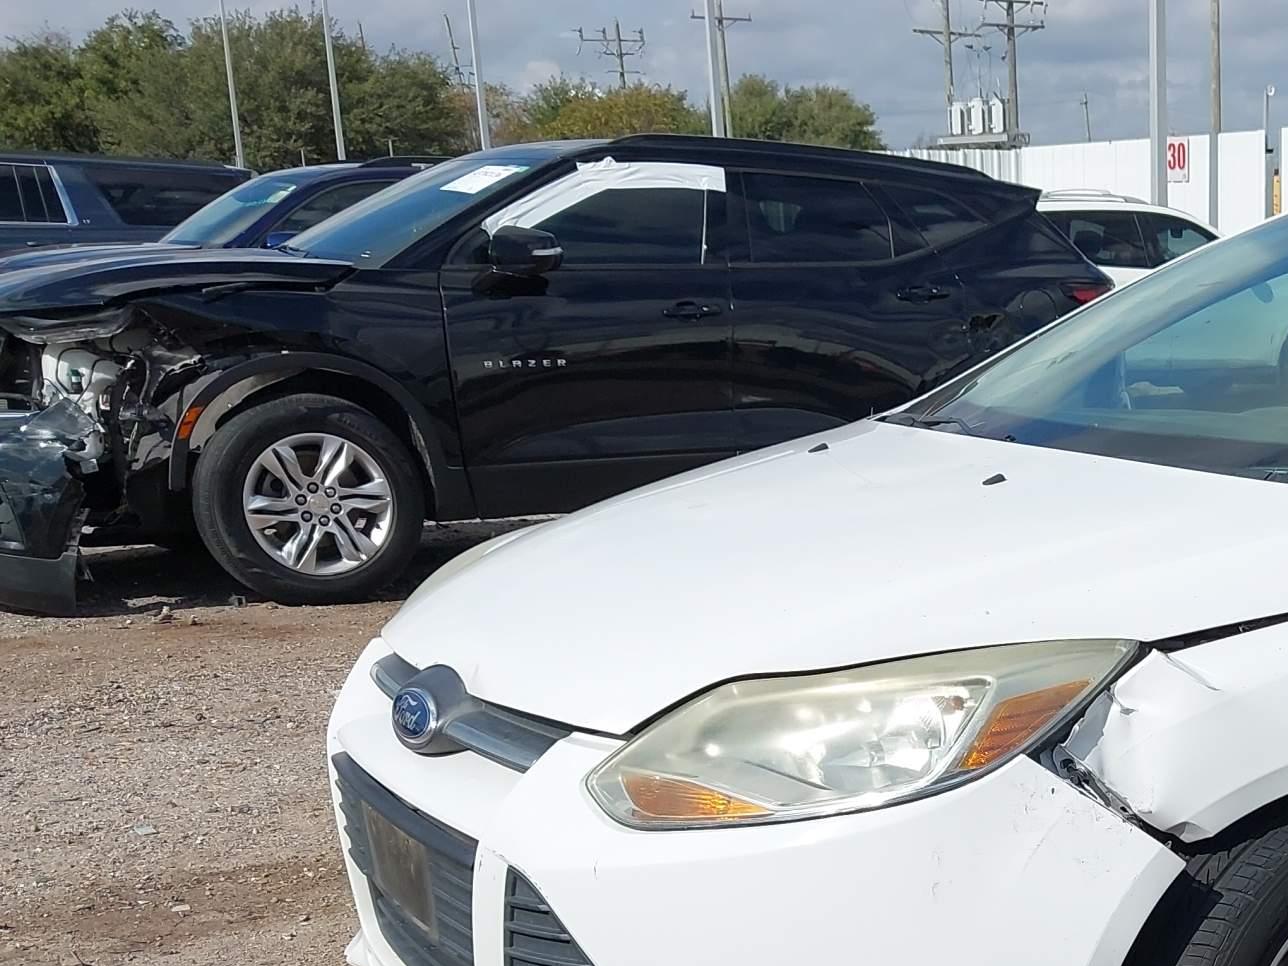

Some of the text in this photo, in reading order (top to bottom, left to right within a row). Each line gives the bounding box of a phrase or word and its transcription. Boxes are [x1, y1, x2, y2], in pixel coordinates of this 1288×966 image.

[1168, 142, 1186, 170] 30
[483, 359, 567, 369] BLAZER
[395, 694, 421, 731] Ford
